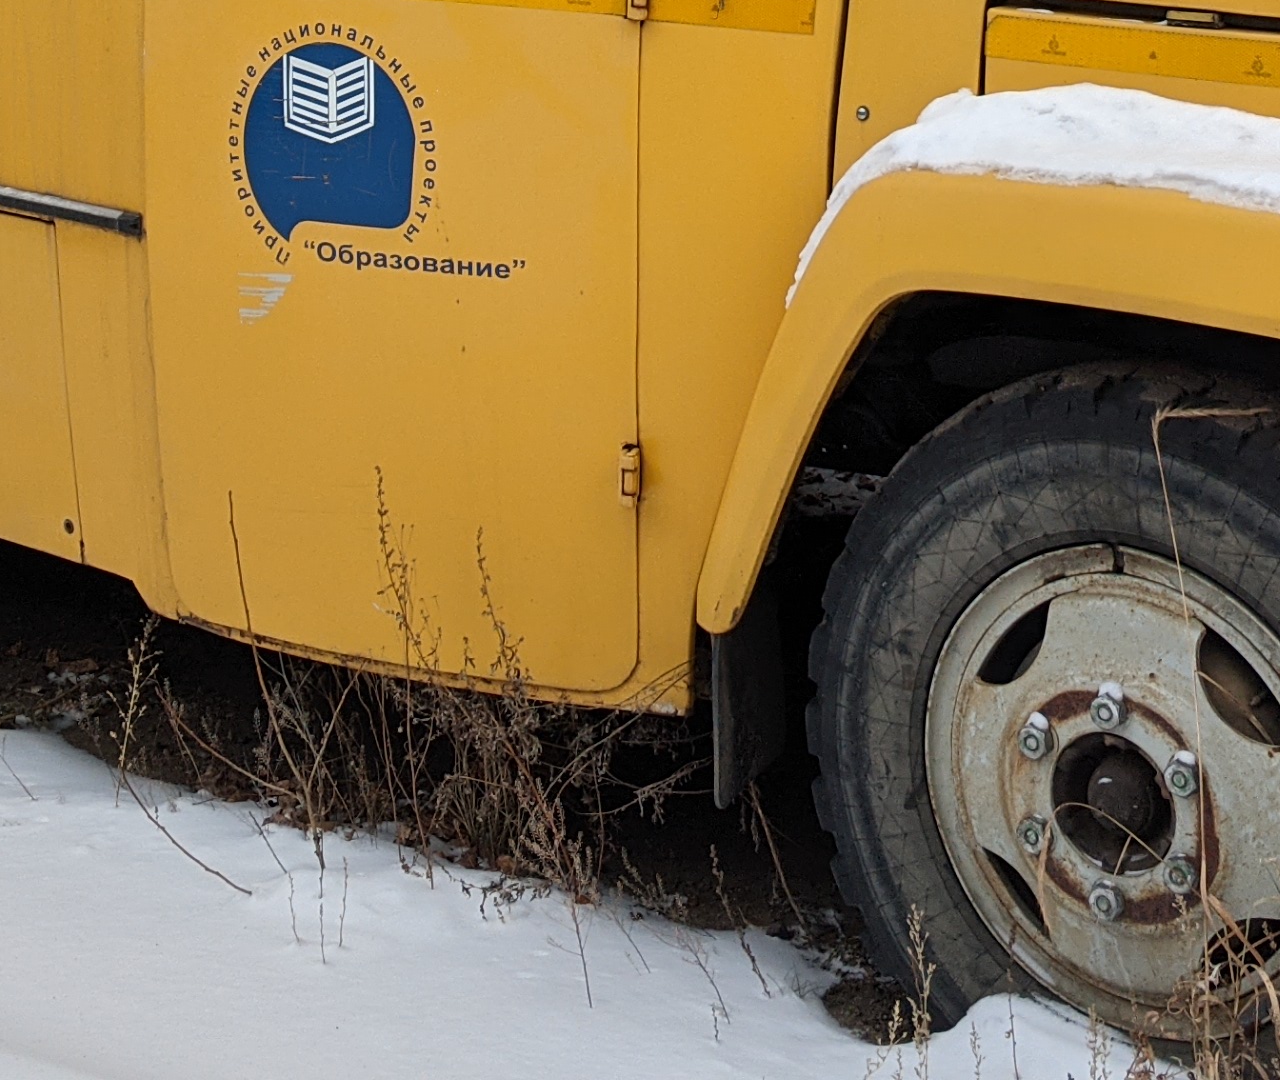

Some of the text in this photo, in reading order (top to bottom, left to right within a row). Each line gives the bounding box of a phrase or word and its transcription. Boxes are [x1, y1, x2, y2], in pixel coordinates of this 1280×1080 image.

[228, 22, 438, 266] Приоритетные национальные проекты
